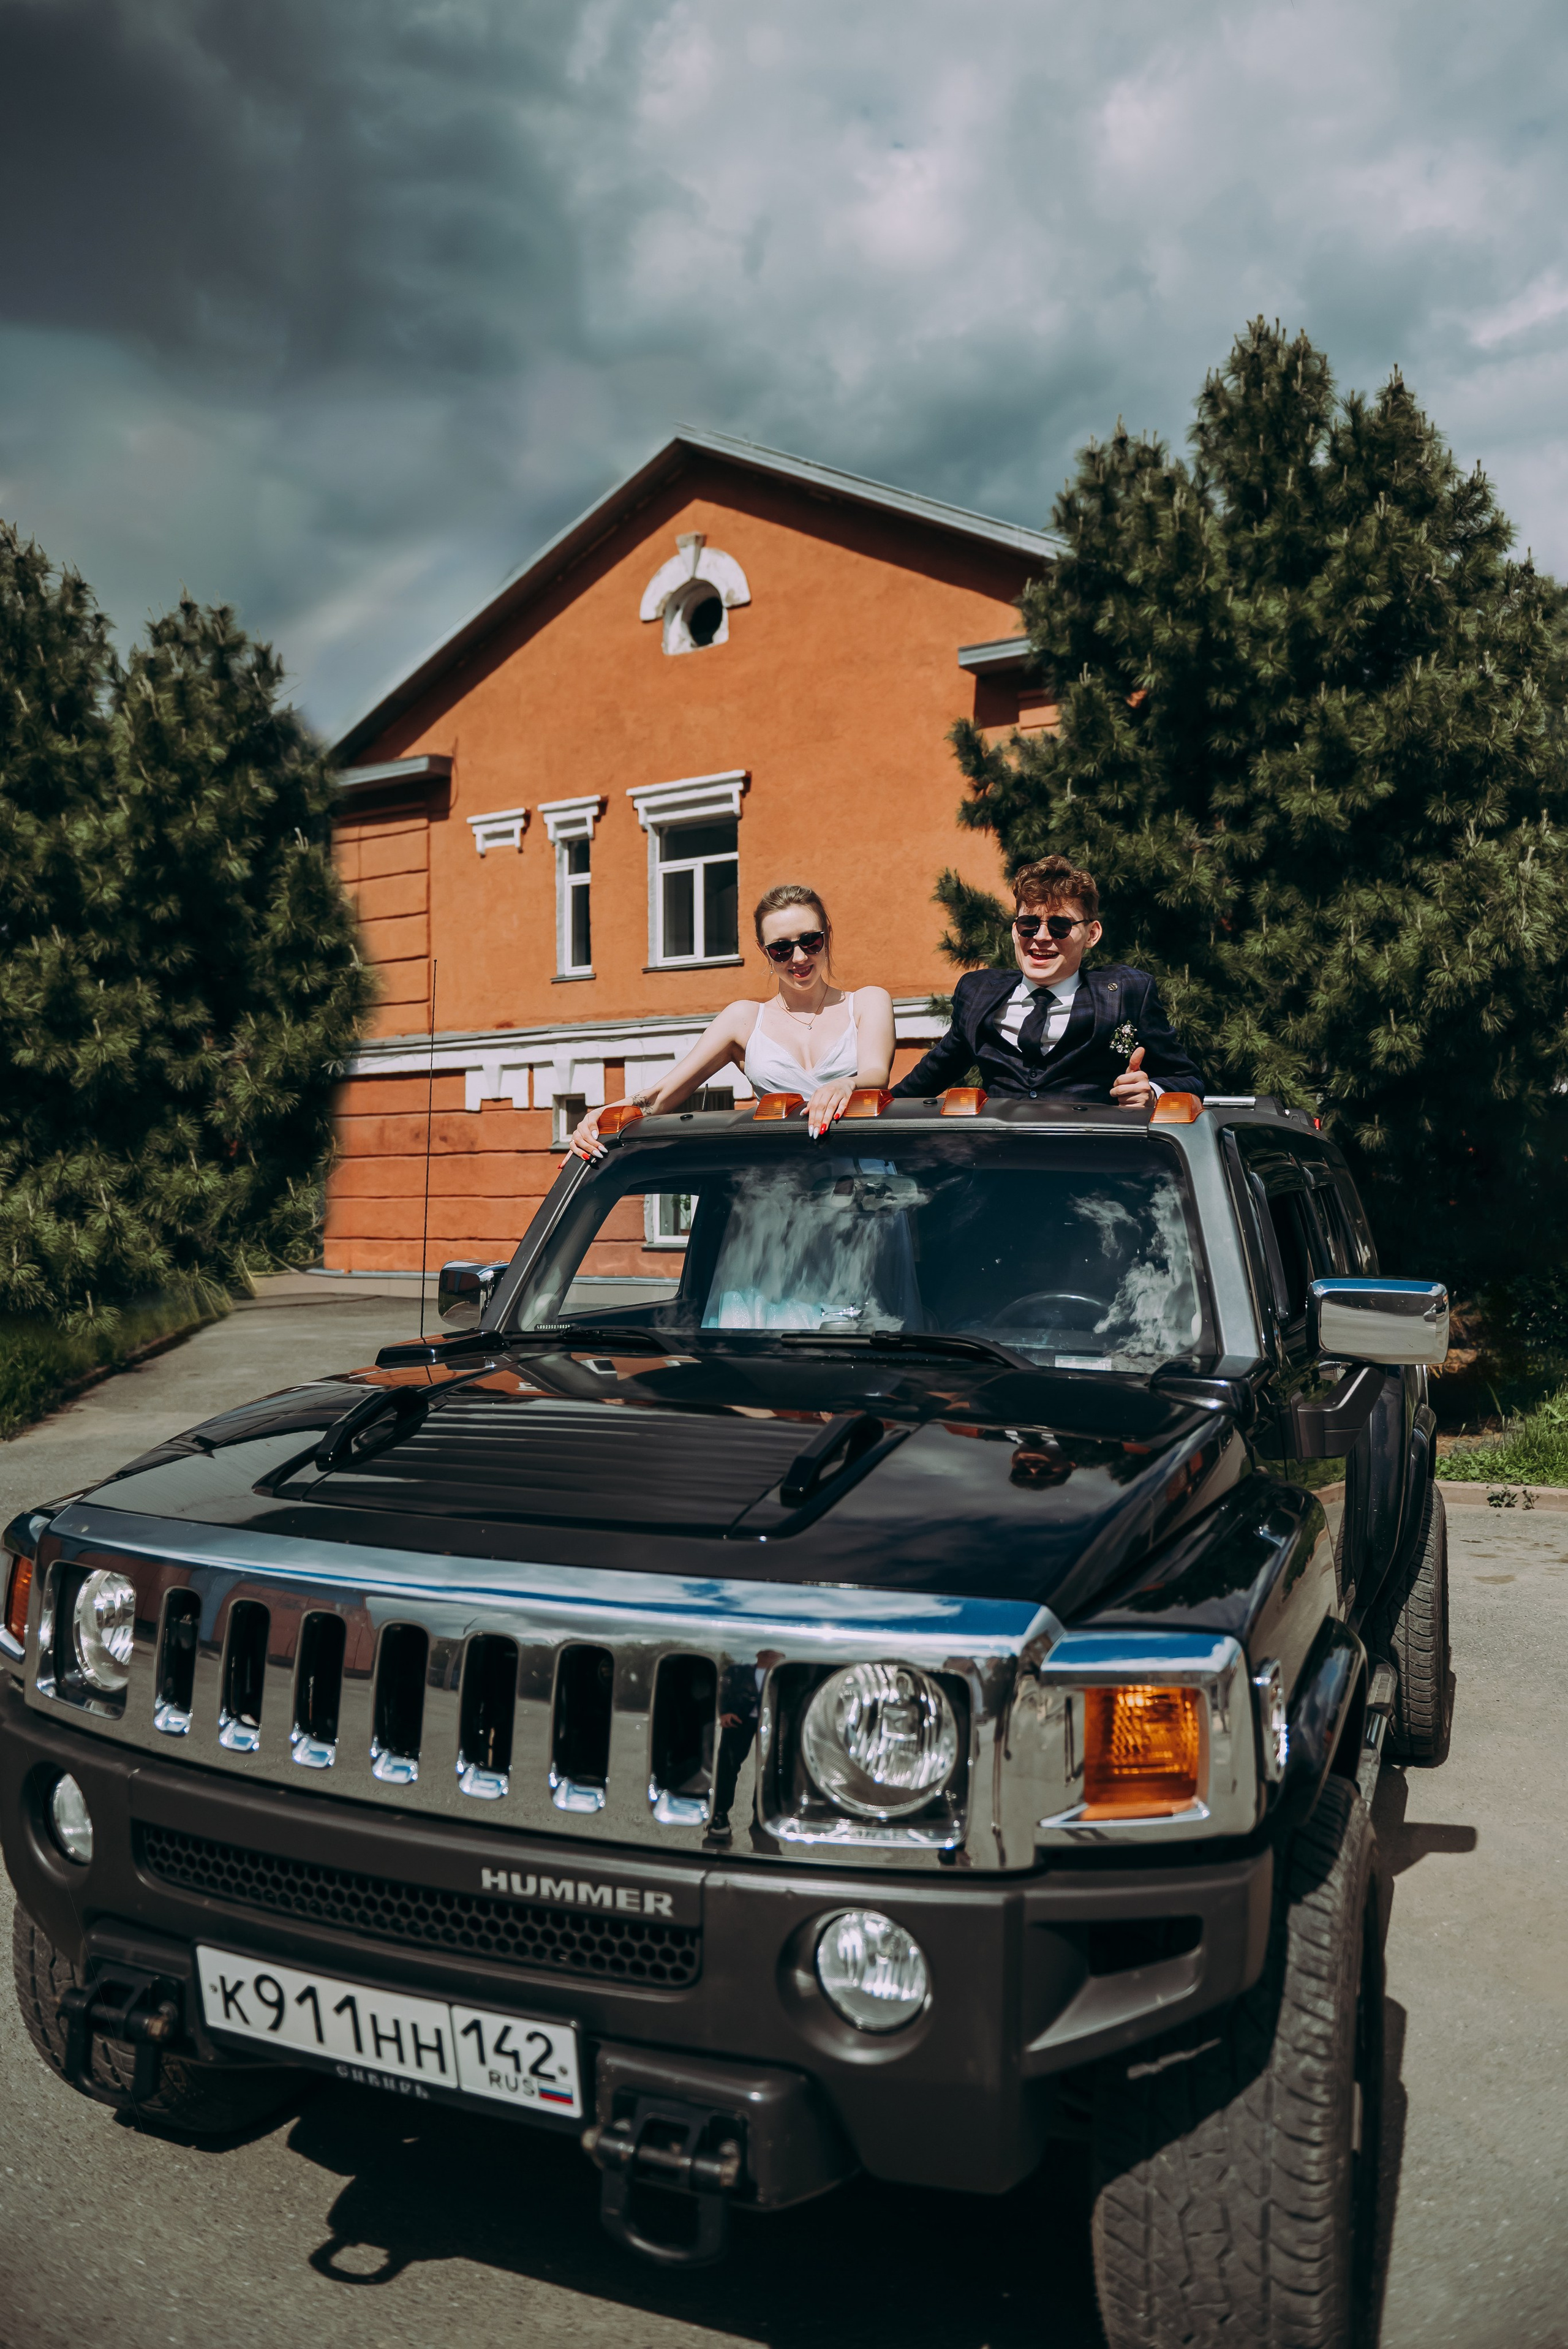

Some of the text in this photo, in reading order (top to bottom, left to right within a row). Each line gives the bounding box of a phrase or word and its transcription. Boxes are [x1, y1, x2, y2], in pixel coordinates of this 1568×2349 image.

[481, 1867, 673, 1917] HUMMER
[461, 2019, 556, 2082] 142
[488, 2068, 535, 2097] RUS
